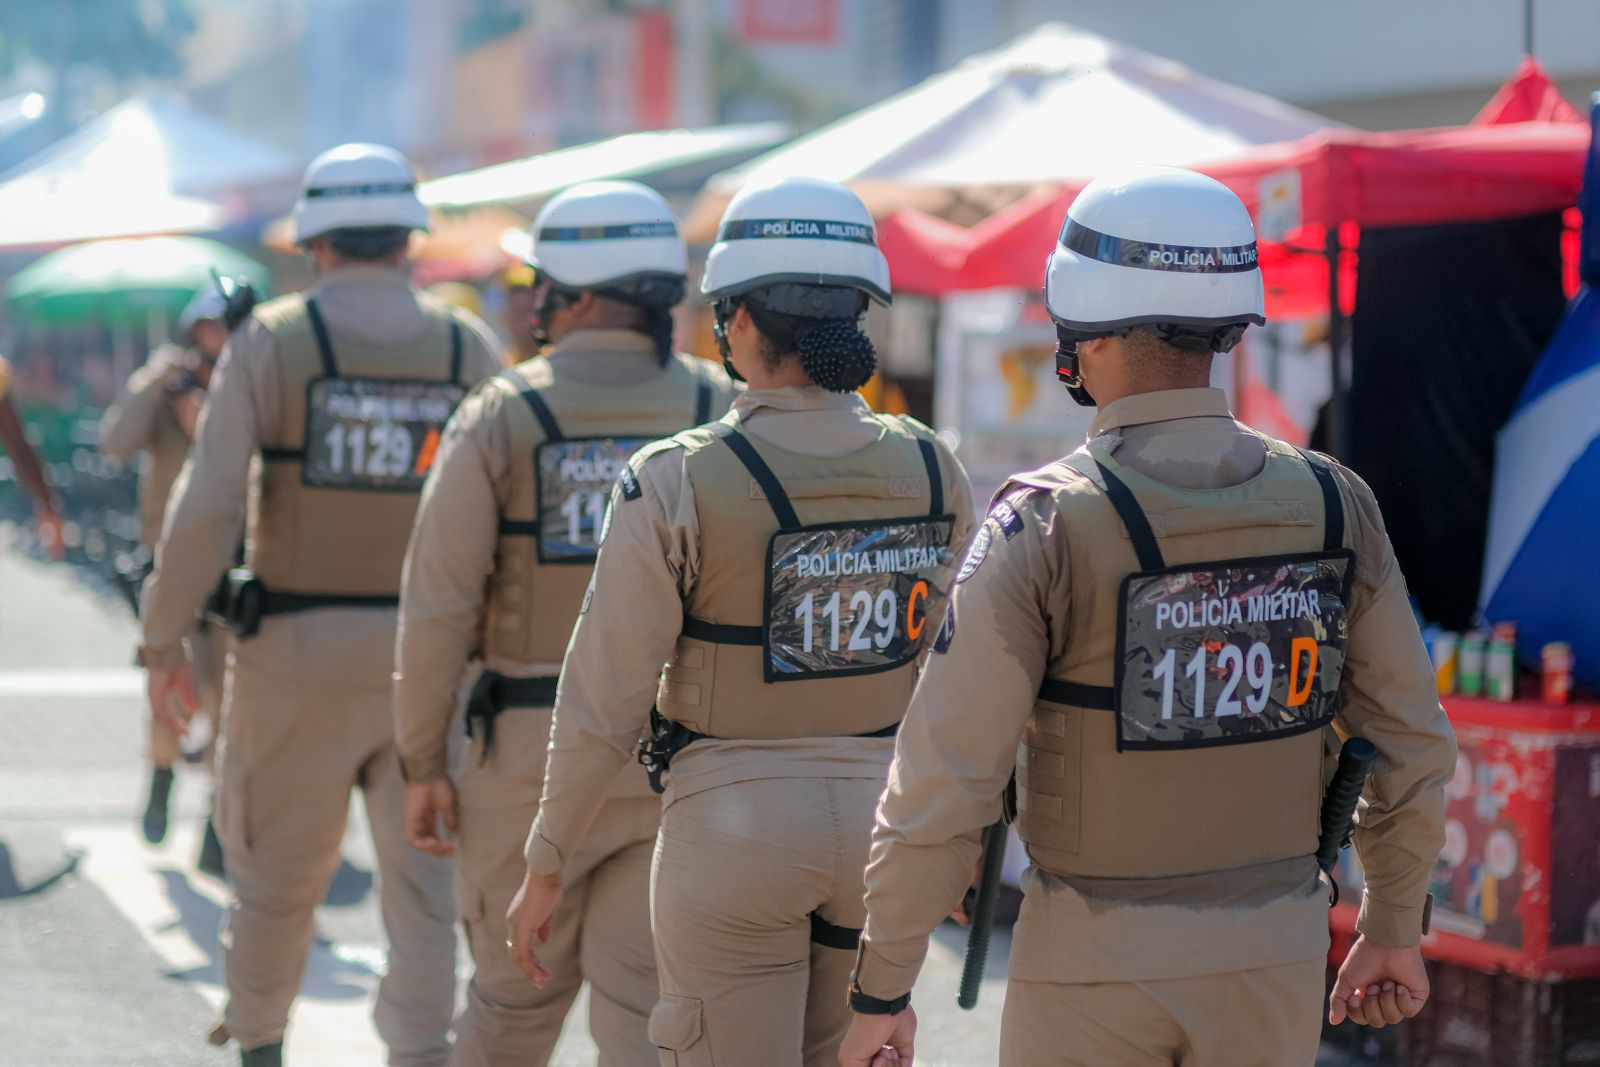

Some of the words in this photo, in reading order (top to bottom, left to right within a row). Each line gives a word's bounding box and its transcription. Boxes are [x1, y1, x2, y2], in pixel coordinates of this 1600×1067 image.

[763, 221, 820, 235] POLÍCIA
[1150, 250, 1215, 266] POLÍCIA
[1222, 249, 1256, 265] MILITAR
[325, 422, 413, 477] 1129
[561, 490, 606, 546] 11
[875, 547, 938, 574] MILITAR
[795, 589, 897, 652] 1129
[907, 580, 928, 640] C
[1156, 592, 1243, 630] POLÍCIA
[1247, 589, 1322, 623] MILITAR
[1153, 642, 1273, 720] 1129
[1286, 636, 1319, 707] D
